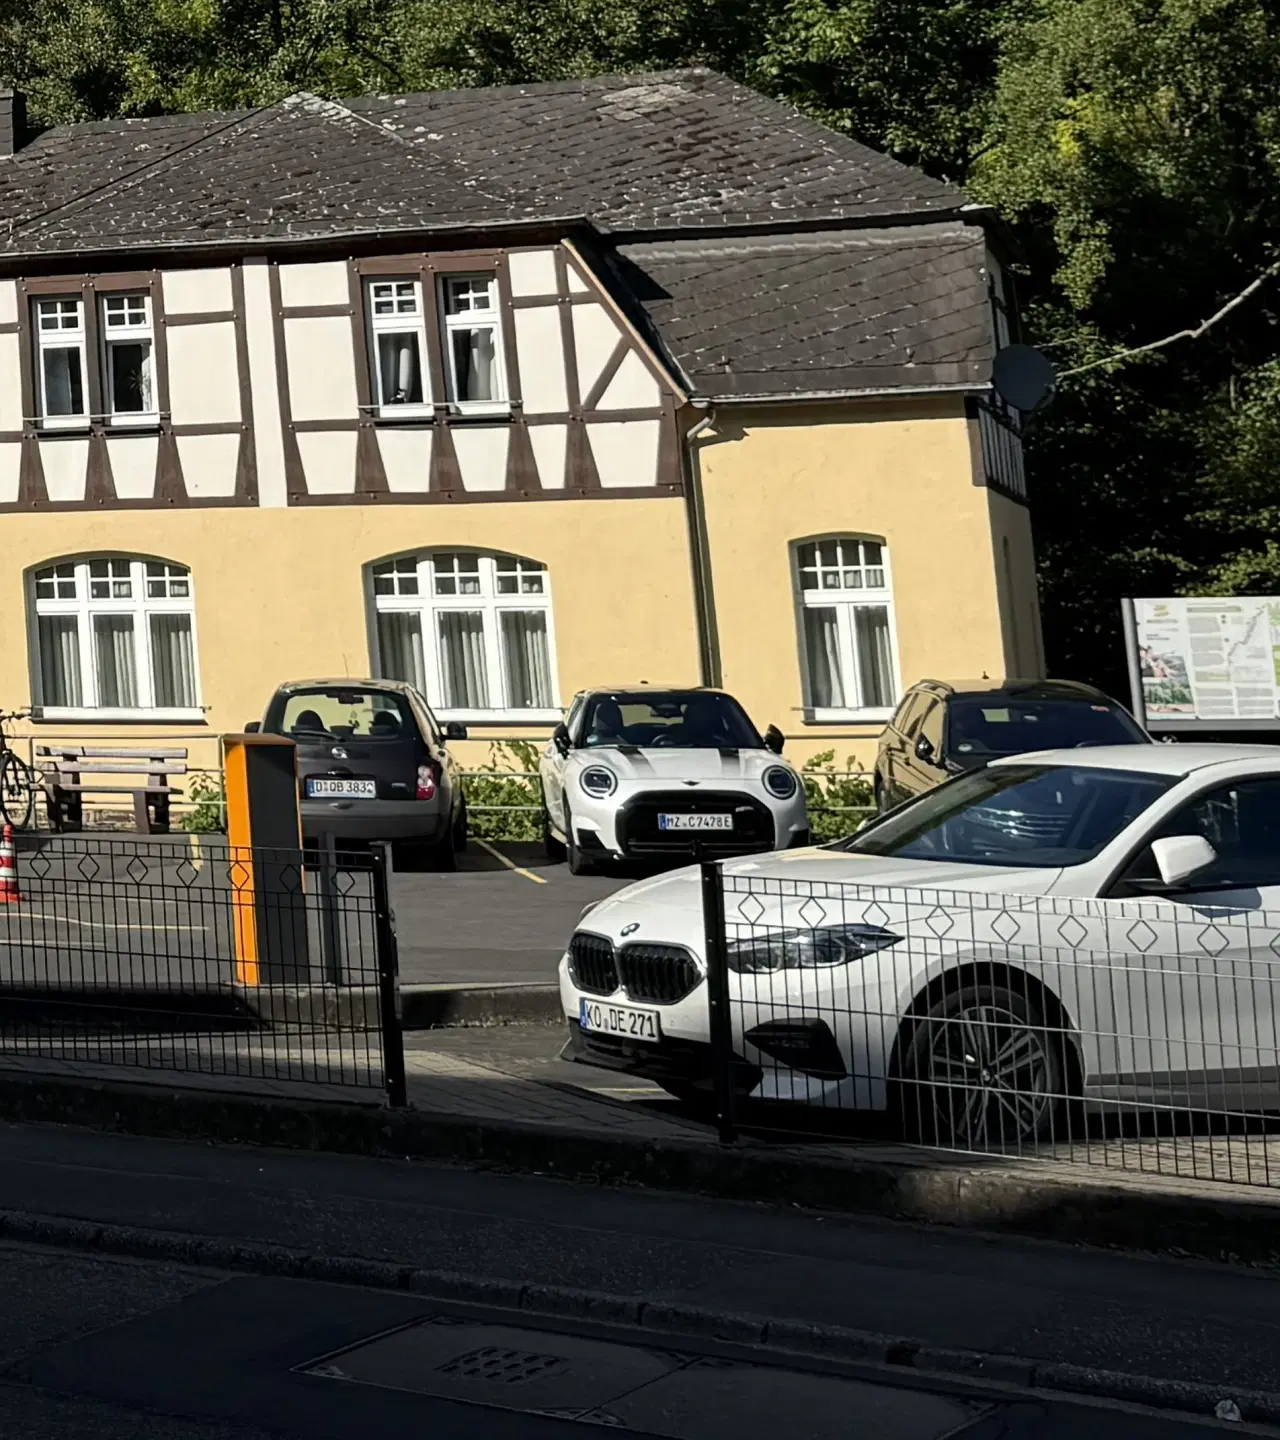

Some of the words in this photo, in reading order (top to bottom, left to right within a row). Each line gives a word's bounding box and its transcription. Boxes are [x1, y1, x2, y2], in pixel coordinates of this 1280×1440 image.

[315, 781, 323, 792] D
[666, 816, 680, 828] MZ
[586, 1004, 602, 1028] KO
[609, 1008, 627, 1033] DE
[629, 1012, 657, 1038] 271
